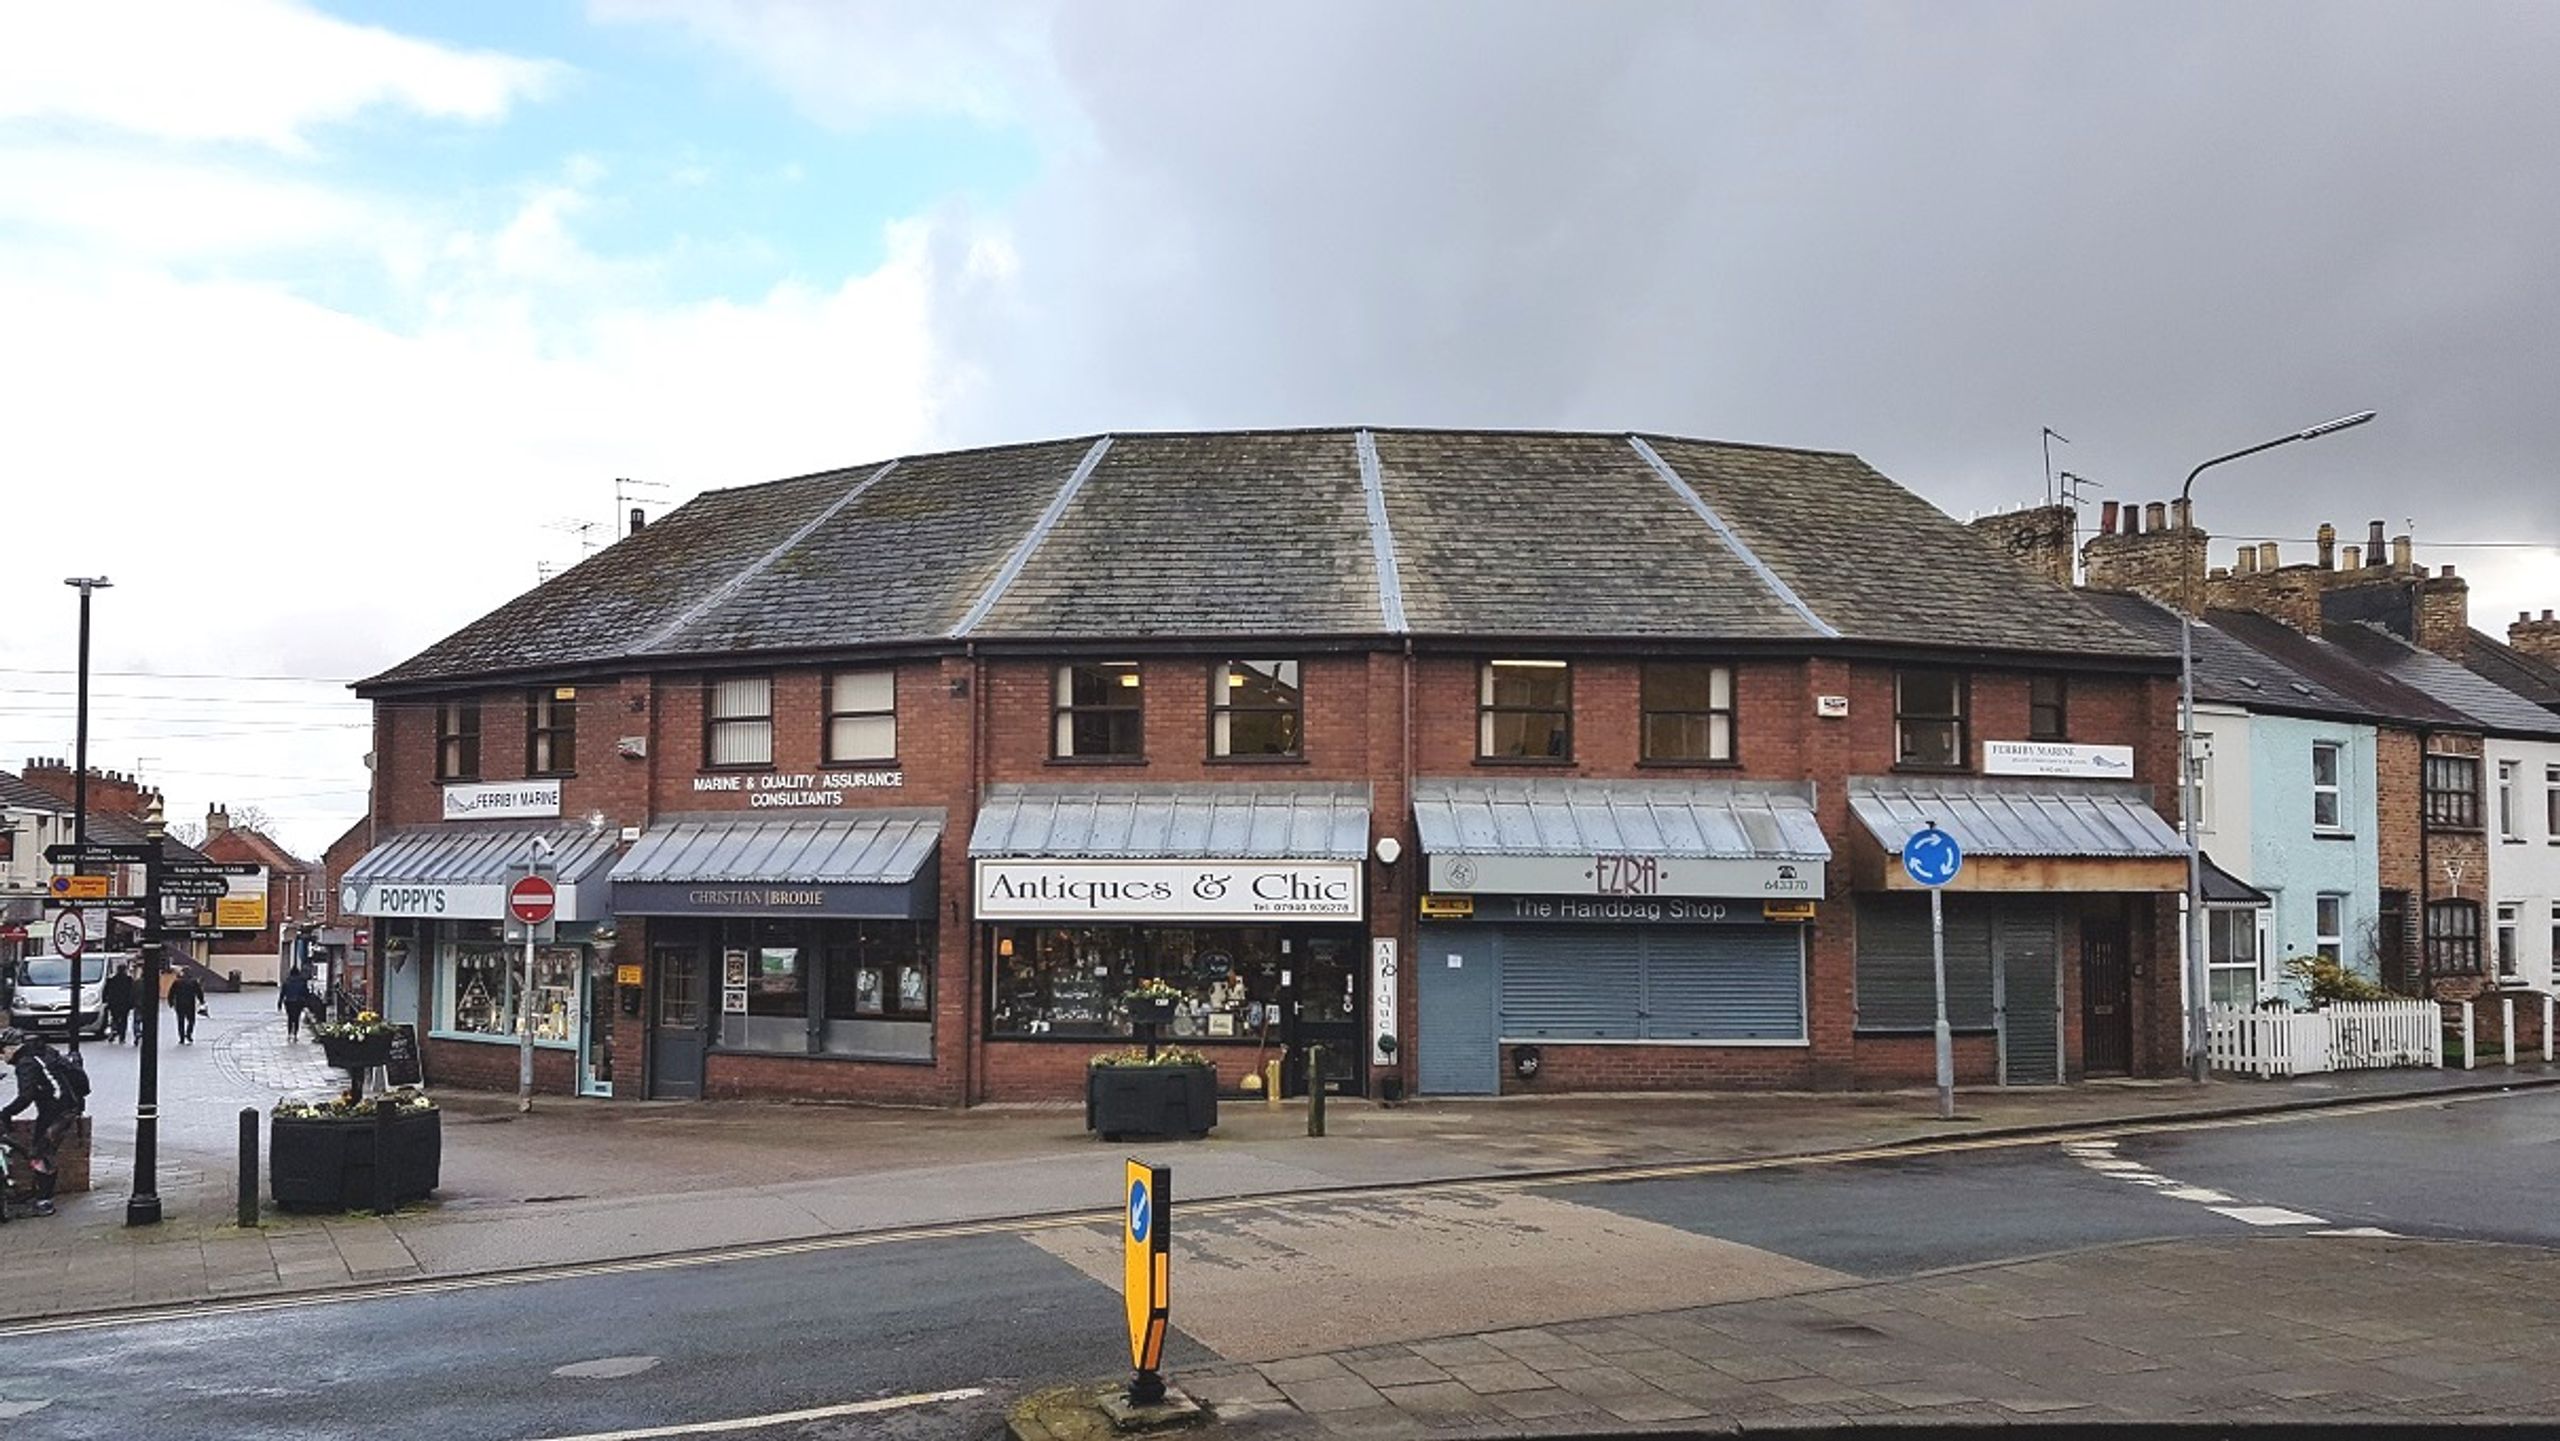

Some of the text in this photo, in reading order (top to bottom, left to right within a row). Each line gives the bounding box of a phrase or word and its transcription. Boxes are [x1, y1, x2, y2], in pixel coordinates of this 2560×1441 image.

[694, 772, 903, 791] MARINE & QUALITY ASSURANCE
[520, 790, 558, 806] MARINE
[751, 791, 843, 807] CONSULTANTS
[1595, 855, 1656, 894] EZRA
[380, 888, 446, 912] POPPY'S
[689, 890, 824, 905] CHRISTIAN BRODIE
[989, 872, 1349, 908] Antiques & Chic
[1514, 899, 1726, 920] The Handbag Shop
